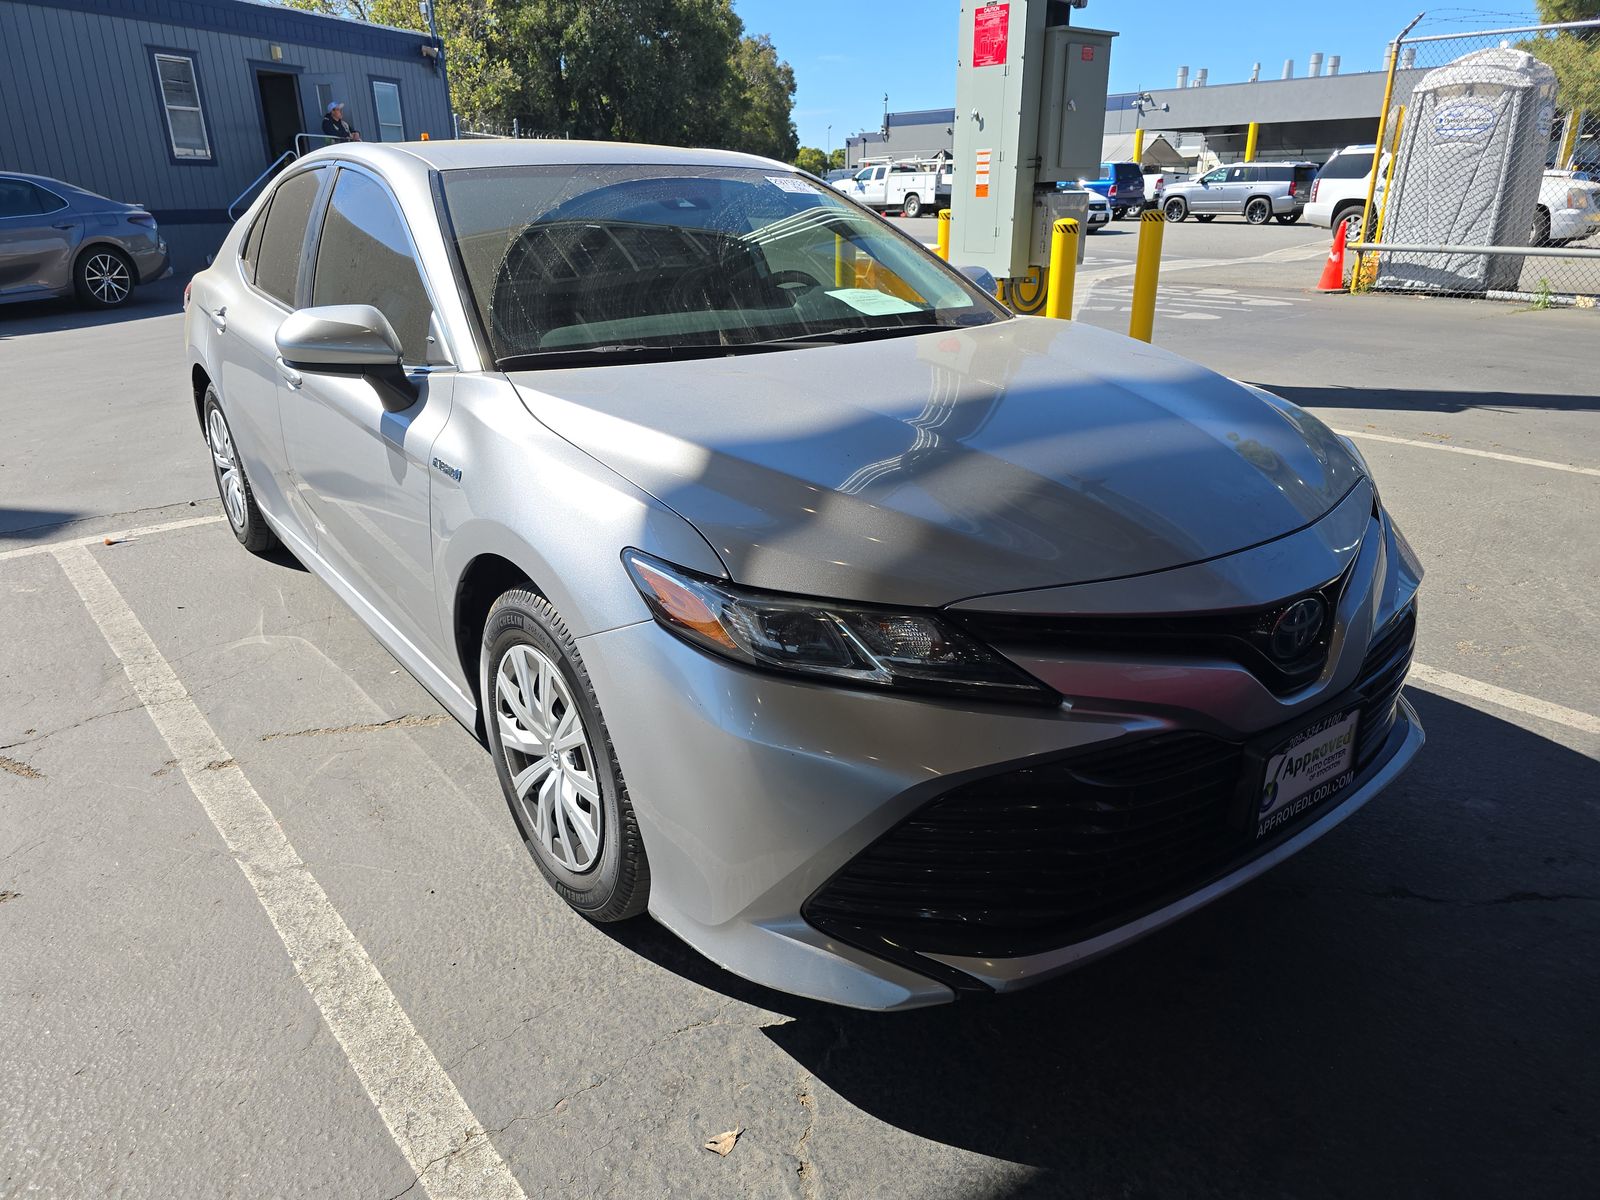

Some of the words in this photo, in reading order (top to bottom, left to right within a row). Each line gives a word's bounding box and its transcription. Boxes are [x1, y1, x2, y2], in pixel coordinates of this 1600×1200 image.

[983, 5, 1001, 14] CAUTION
[1306, 763, 1323, 777] AUTO
[1323, 748, 1347, 767] CENTER
